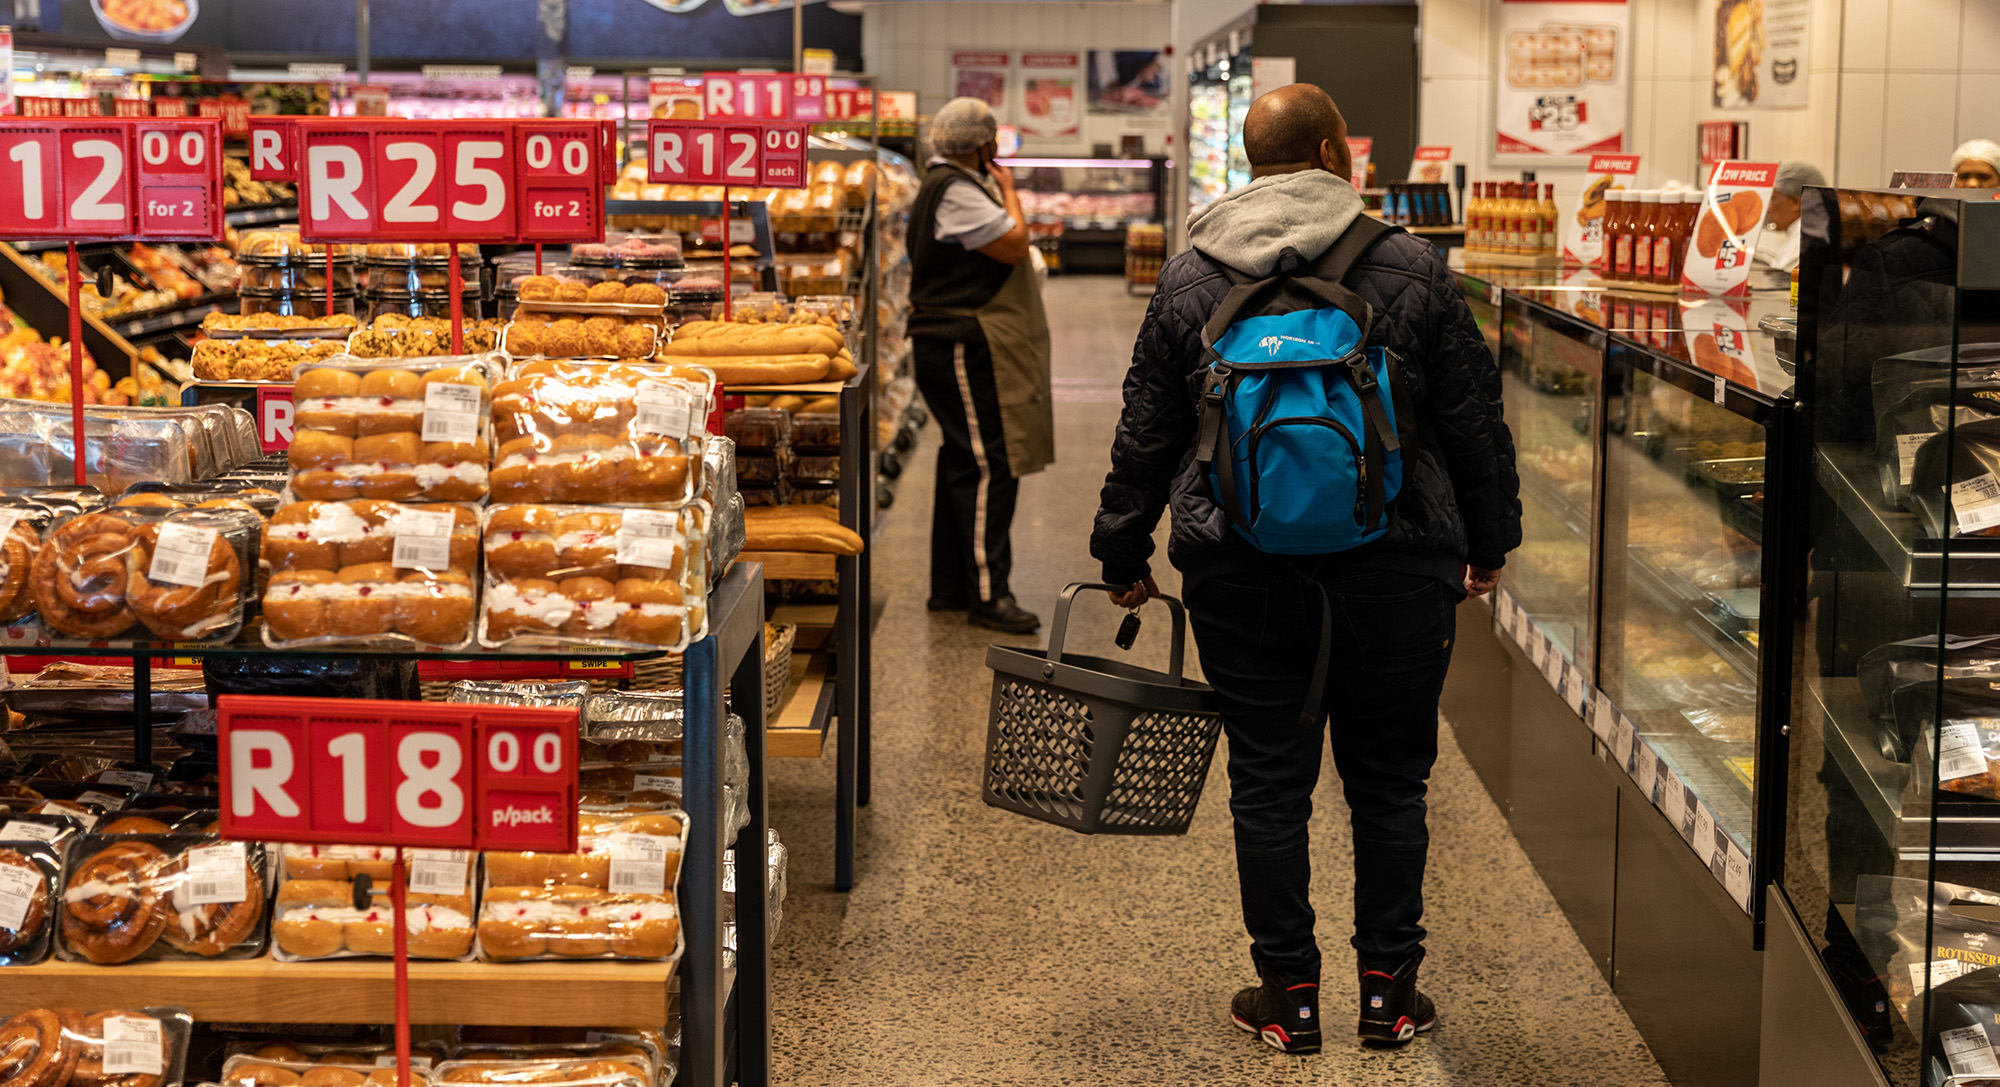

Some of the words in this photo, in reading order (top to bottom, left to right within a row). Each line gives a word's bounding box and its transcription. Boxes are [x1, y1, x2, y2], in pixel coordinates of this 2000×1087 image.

[142, 131, 205, 166] 00
[766, 130, 800, 149] 00
[526, 134, 589, 175] 00
[653, 132, 757, 178] R12
[9, 140, 125, 221] 12
[308, 141, 506, 222] R25
[768, 166, 795, 178] each
[1719, 169, 1738, 181] LOW
[1740, 170, 1768, 182] PRICE
[148, 201, 177, 217] for
[182, 201, 194, 216] 2
[534, 201, 563, 217] for
[568, 201, 580, 217] 2
[581, 660, 608, 668] SWIPE
[488, 731, 562, 773] 00
[230, 730, 465, 827] R18
[492, 805, 553, 827] p/pack
[1937, 946, 2000, 966] ROTISSER
